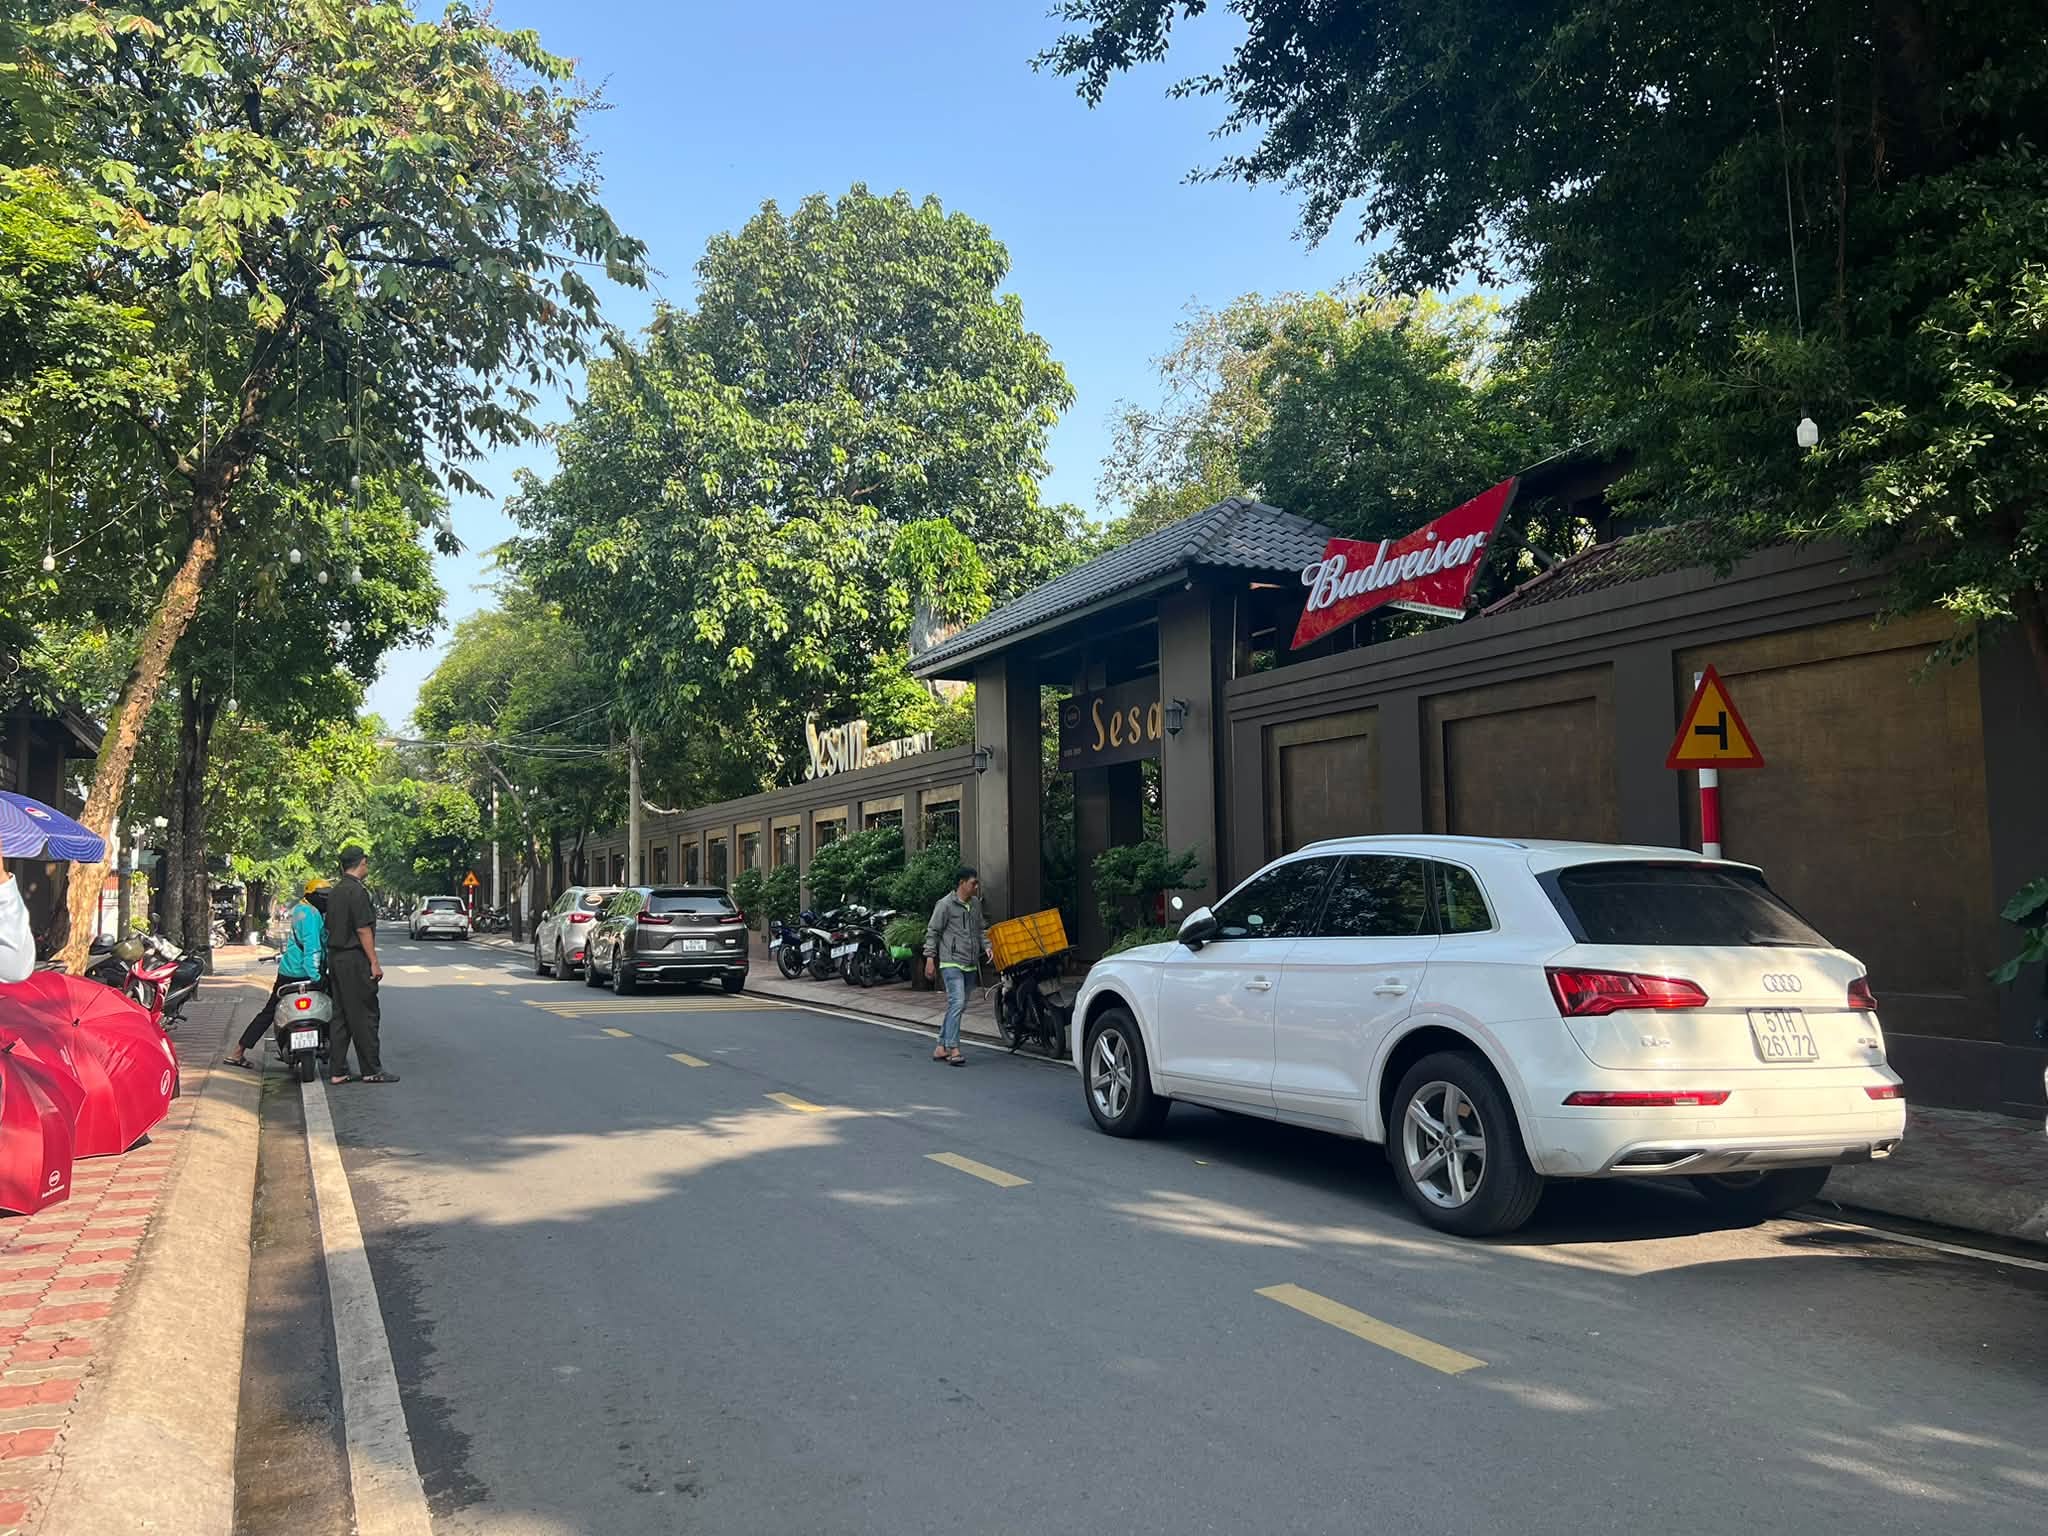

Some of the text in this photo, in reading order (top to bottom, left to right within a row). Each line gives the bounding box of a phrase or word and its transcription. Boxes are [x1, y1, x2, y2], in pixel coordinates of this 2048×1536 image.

[1301, 531, 1488, 612] Budweiser
[1763, 1010, 1797, 1033] 51H
[1762, 1034, 1817, 1057] 261.72
